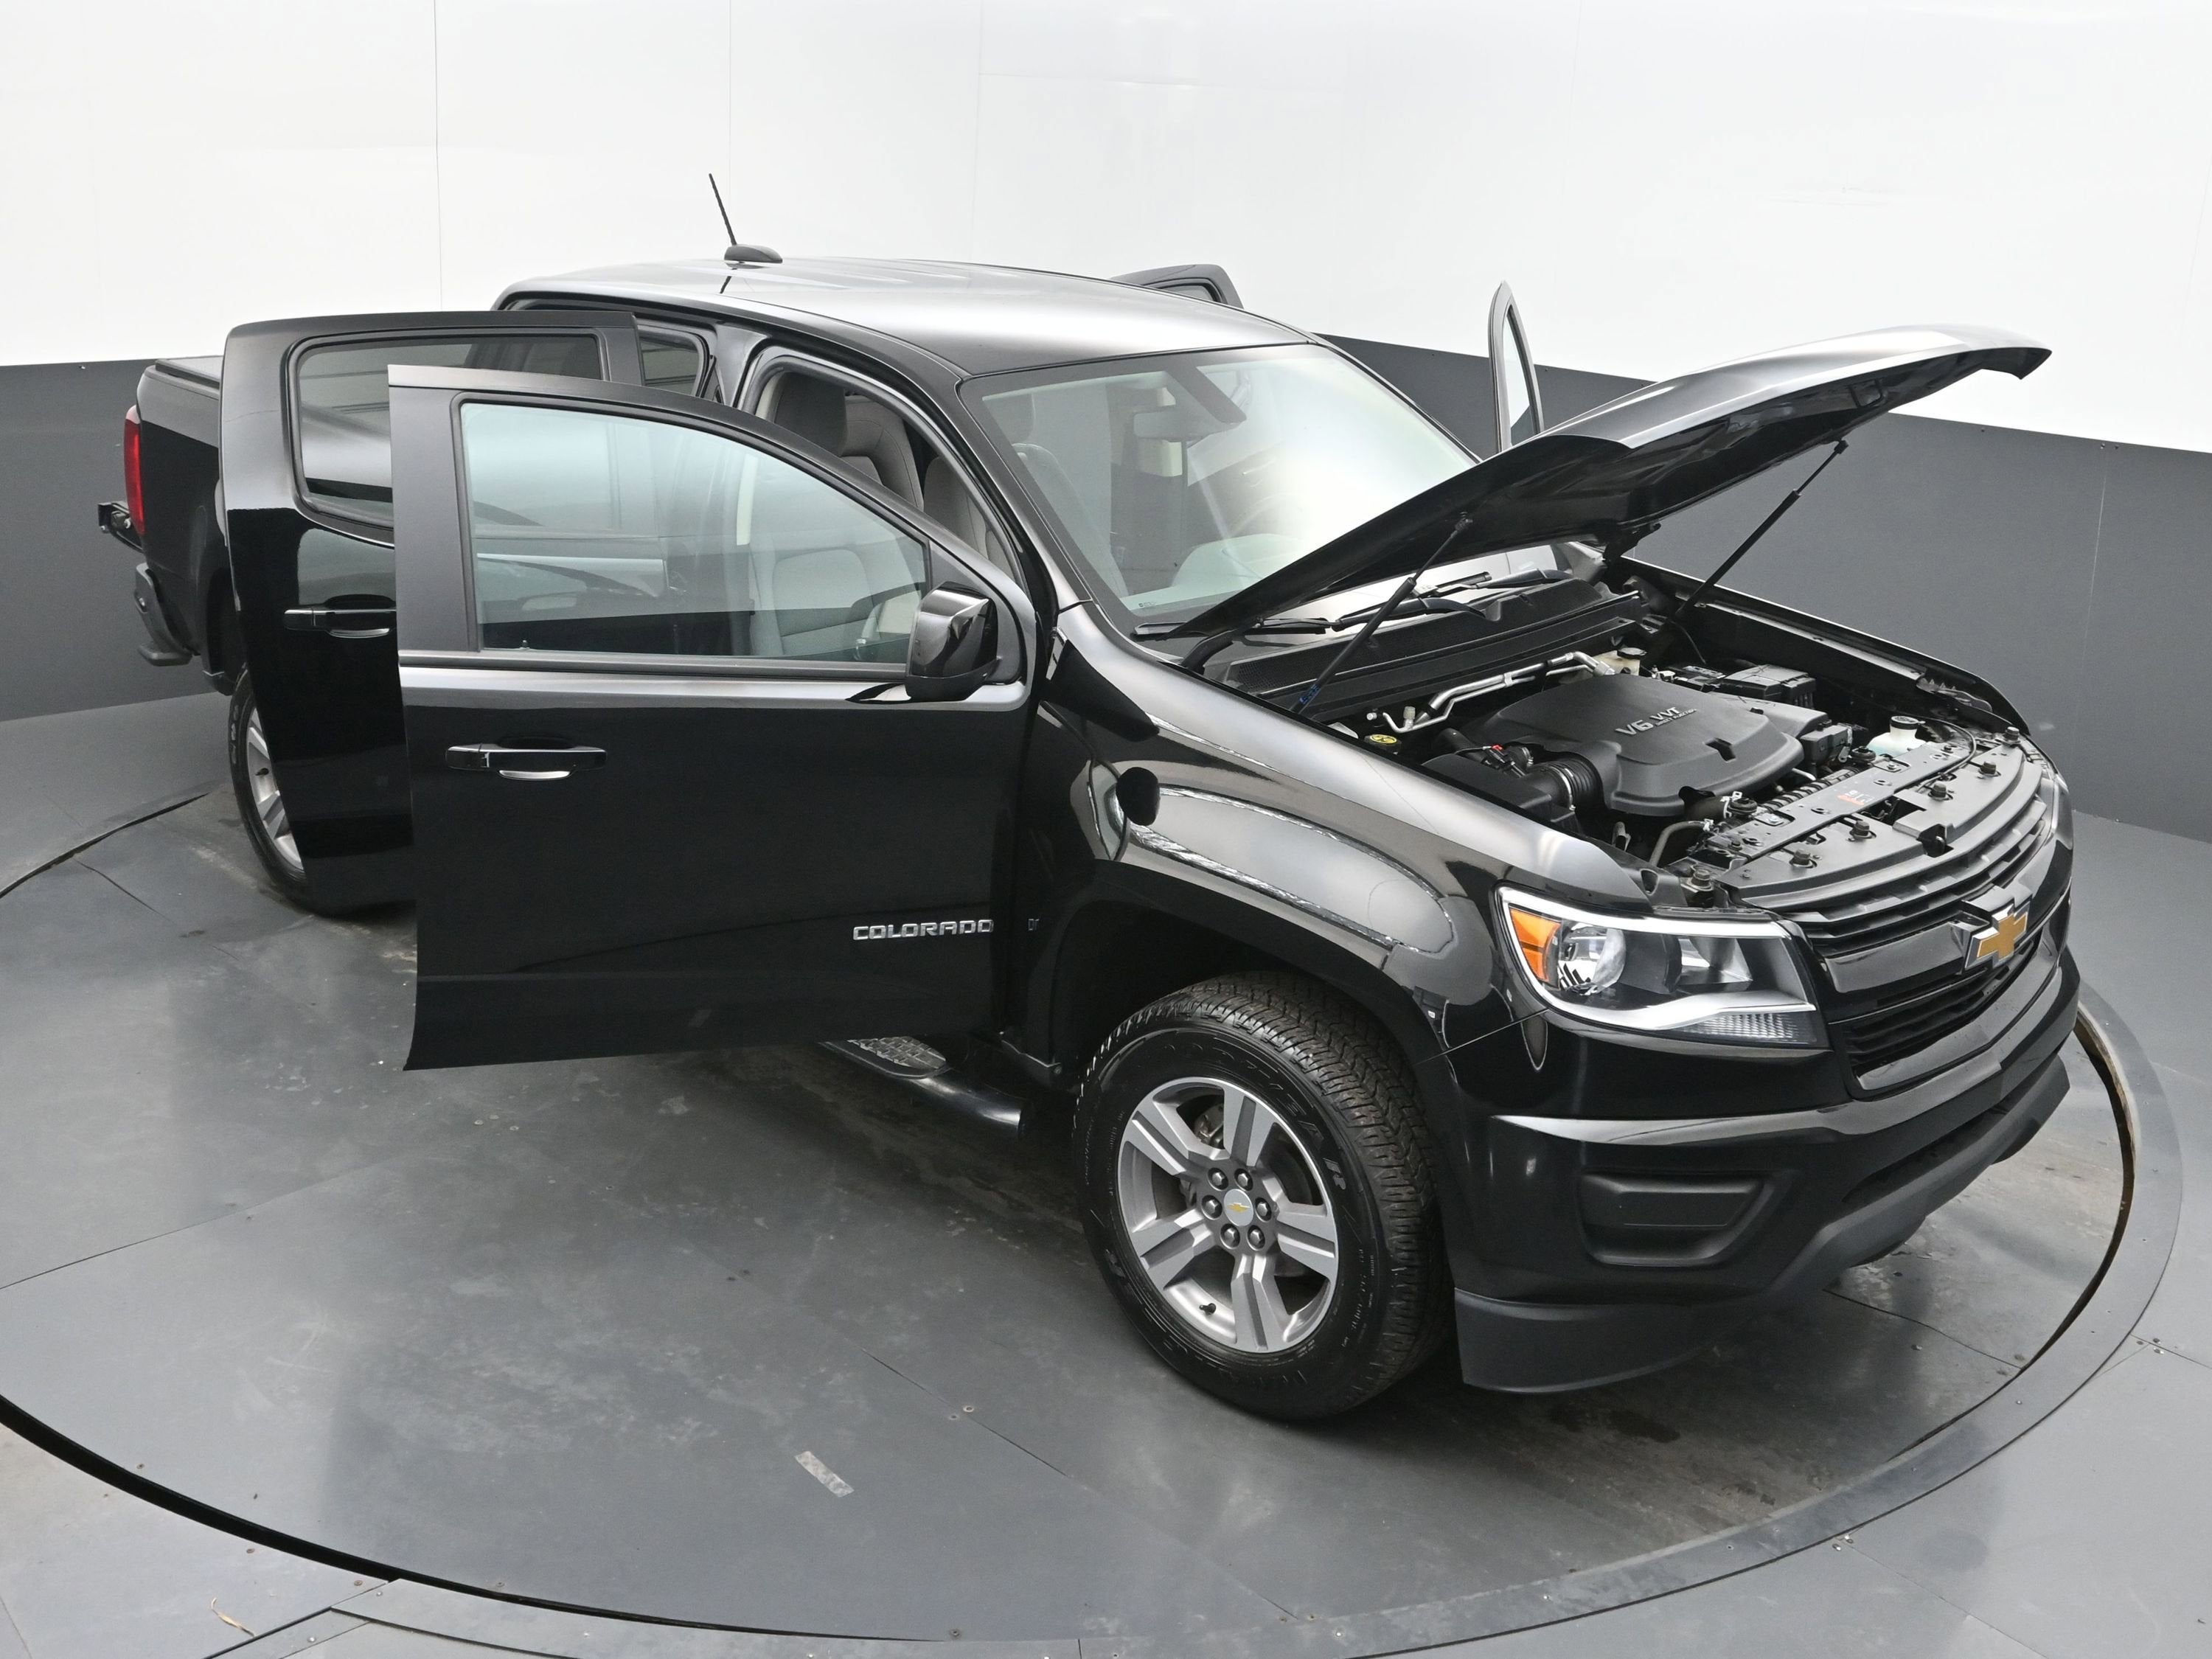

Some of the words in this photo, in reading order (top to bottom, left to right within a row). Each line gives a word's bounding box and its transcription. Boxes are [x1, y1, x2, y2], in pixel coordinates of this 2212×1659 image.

[1615, 720, 1654, 735] V6
[1649, 706, 1680, 720] VVT
[853, 919, 994, 940] COLORADO
